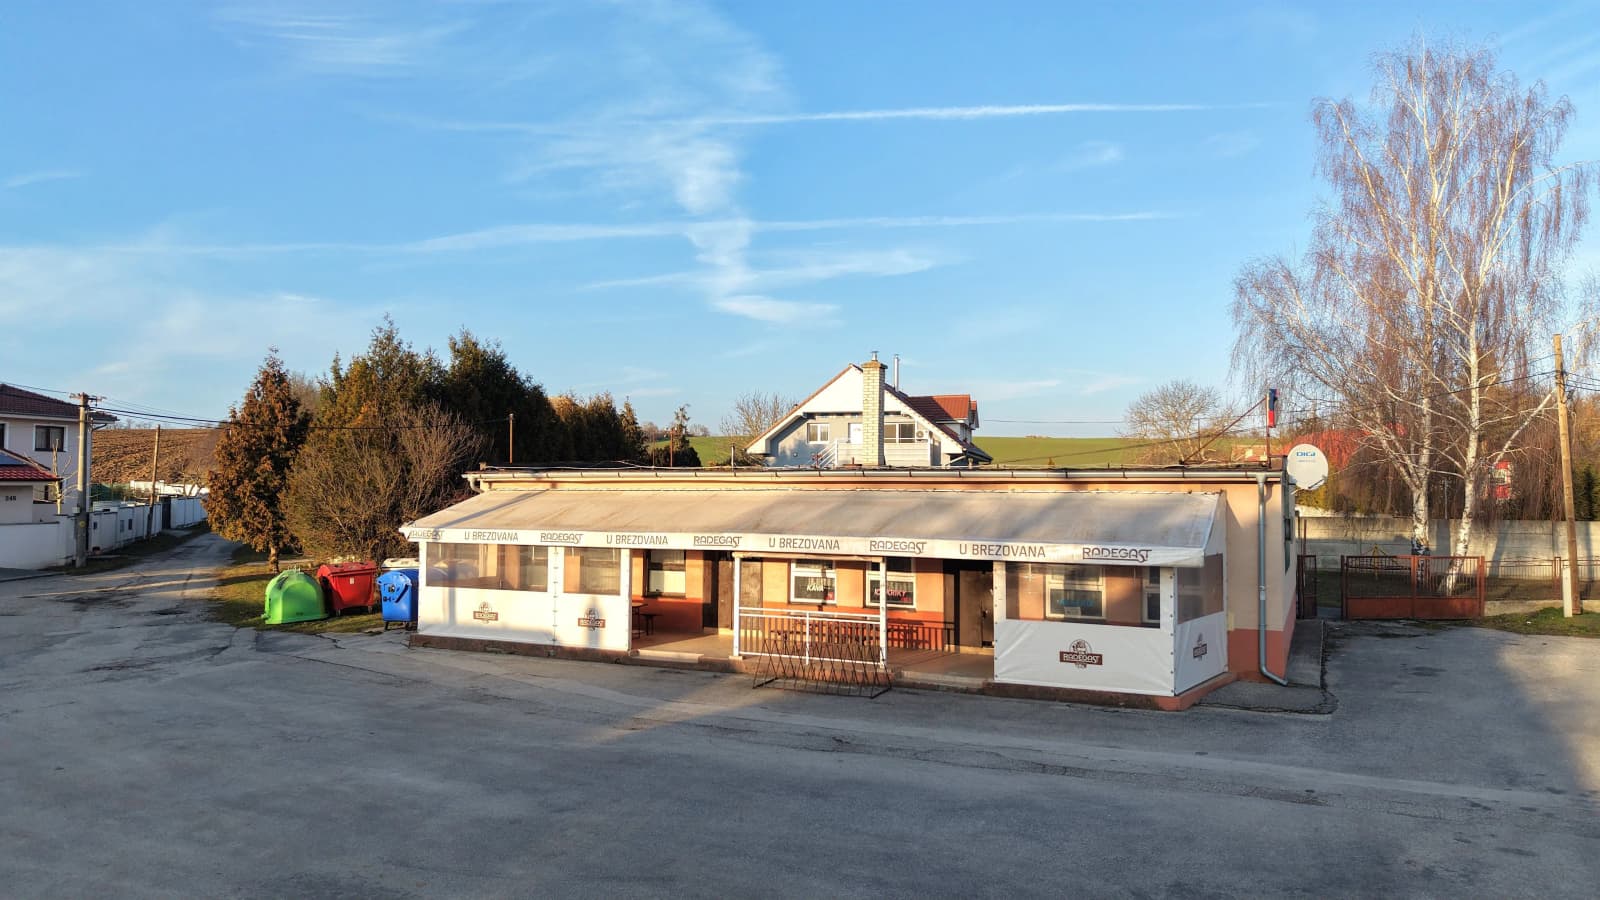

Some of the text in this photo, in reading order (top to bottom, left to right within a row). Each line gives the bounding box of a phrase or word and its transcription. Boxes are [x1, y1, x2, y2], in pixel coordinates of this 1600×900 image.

[464, 530, 519, 542] U BREZOVANA
[540, 532, 585, 545] RADEGAST
[606, 534, 669, 546] U BREZOVANA
[693, 535, 742, 548] RADEGAST
[768, 537, 840, 551] U BREZOVANA
[869, 540, 927, 555] RADEGAST
[959, 543, 1046, 558] U BREZOVANA
[1082, 547, 1153, 563] RADEGAST
